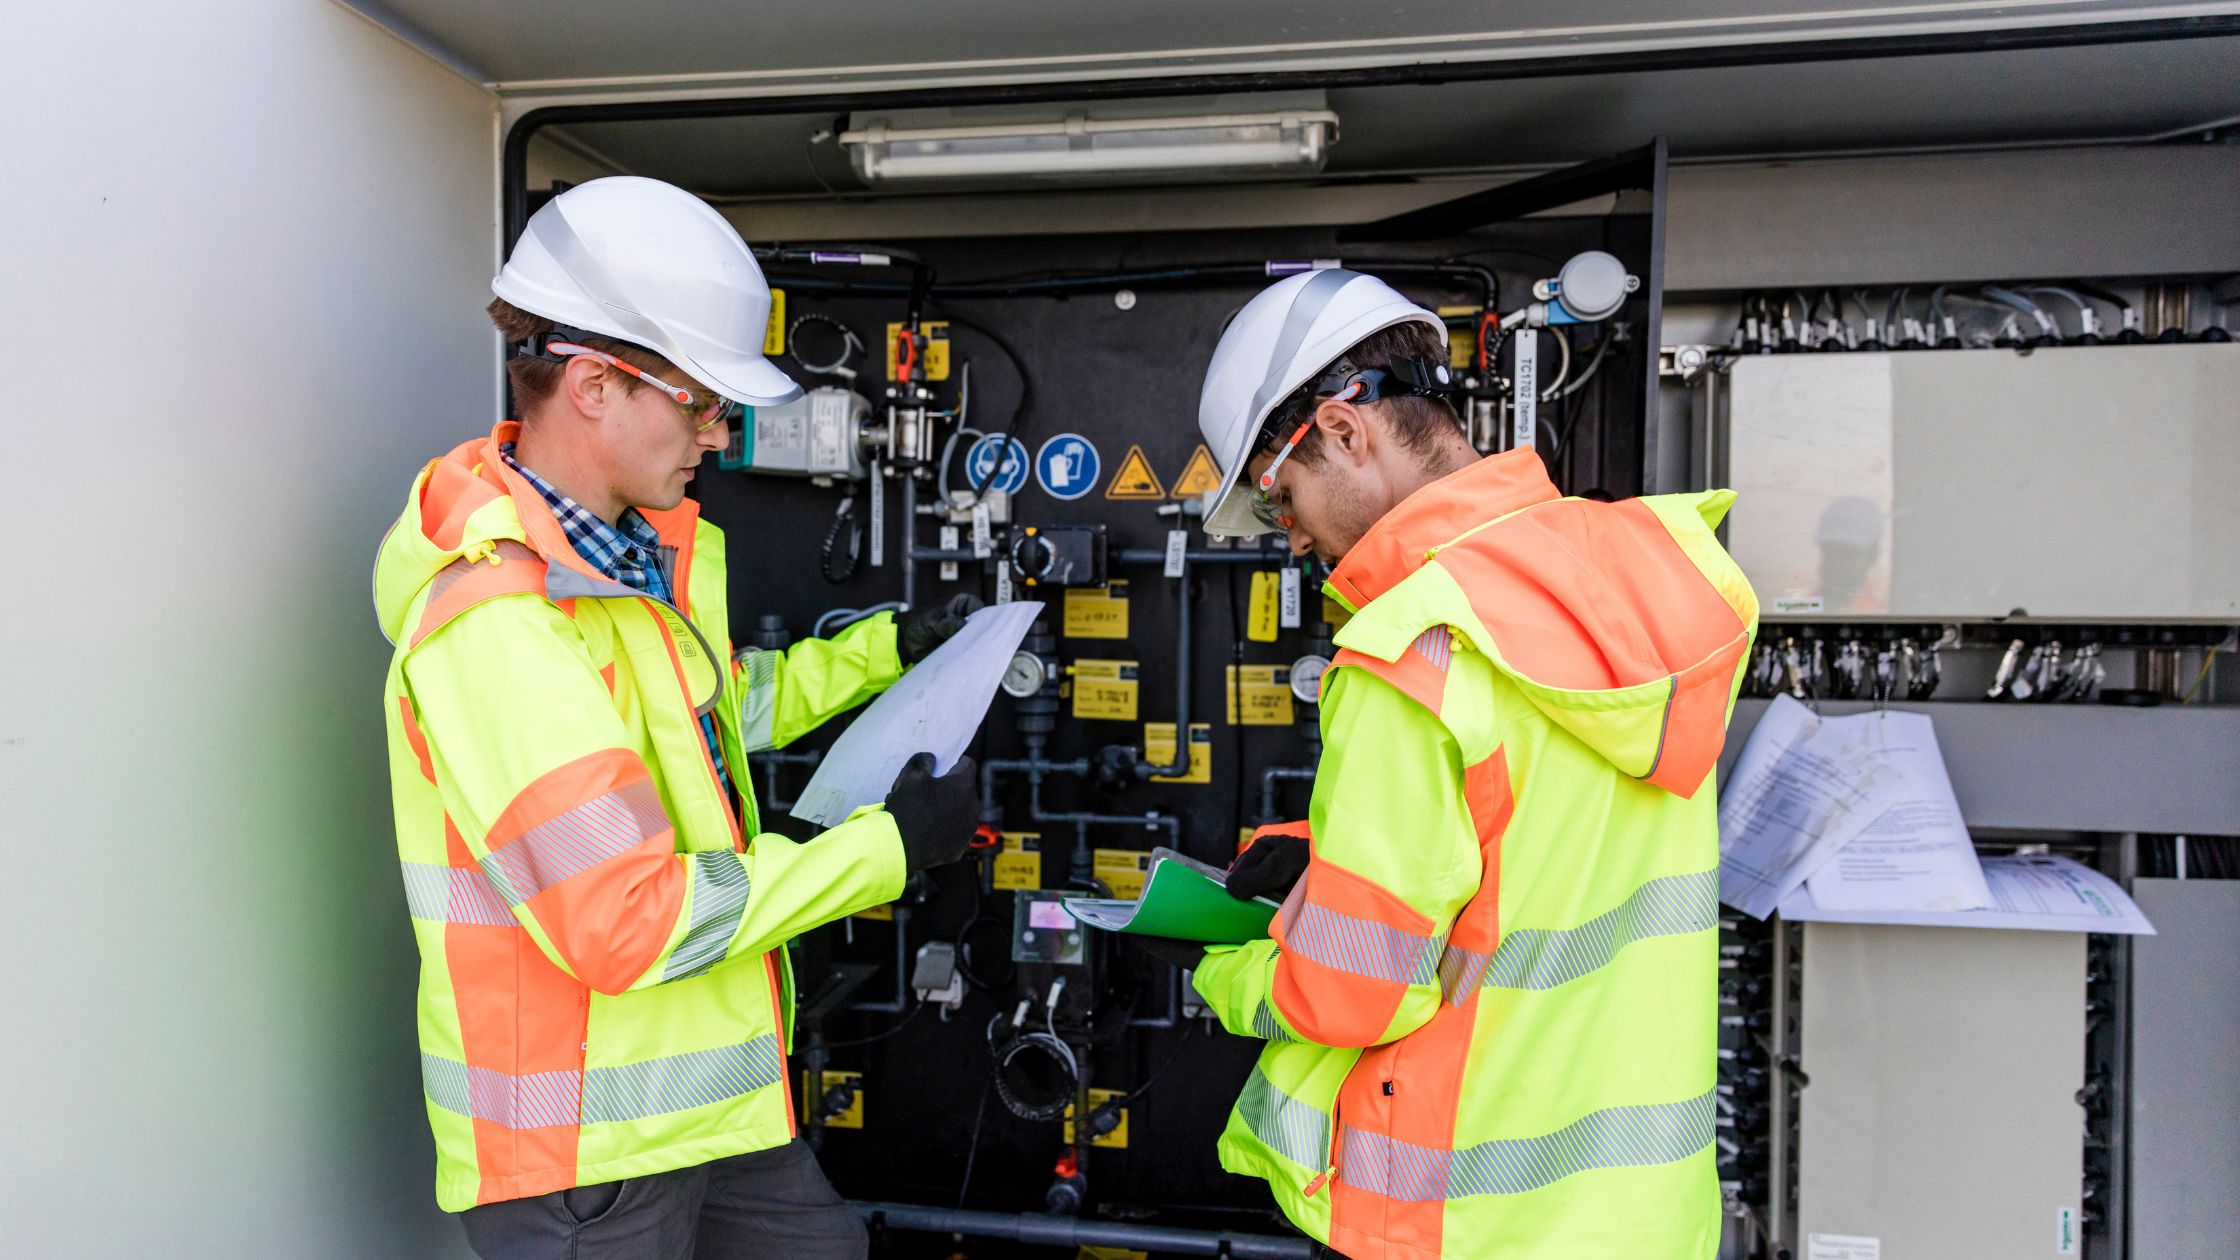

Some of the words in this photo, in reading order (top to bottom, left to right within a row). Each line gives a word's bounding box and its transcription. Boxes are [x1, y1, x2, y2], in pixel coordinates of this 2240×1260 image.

[1520, 358, 1532, 398] TC1702
[1518, 401, 1530, 440] (temp.)
[1286, 585, 1296, 617] V1720
